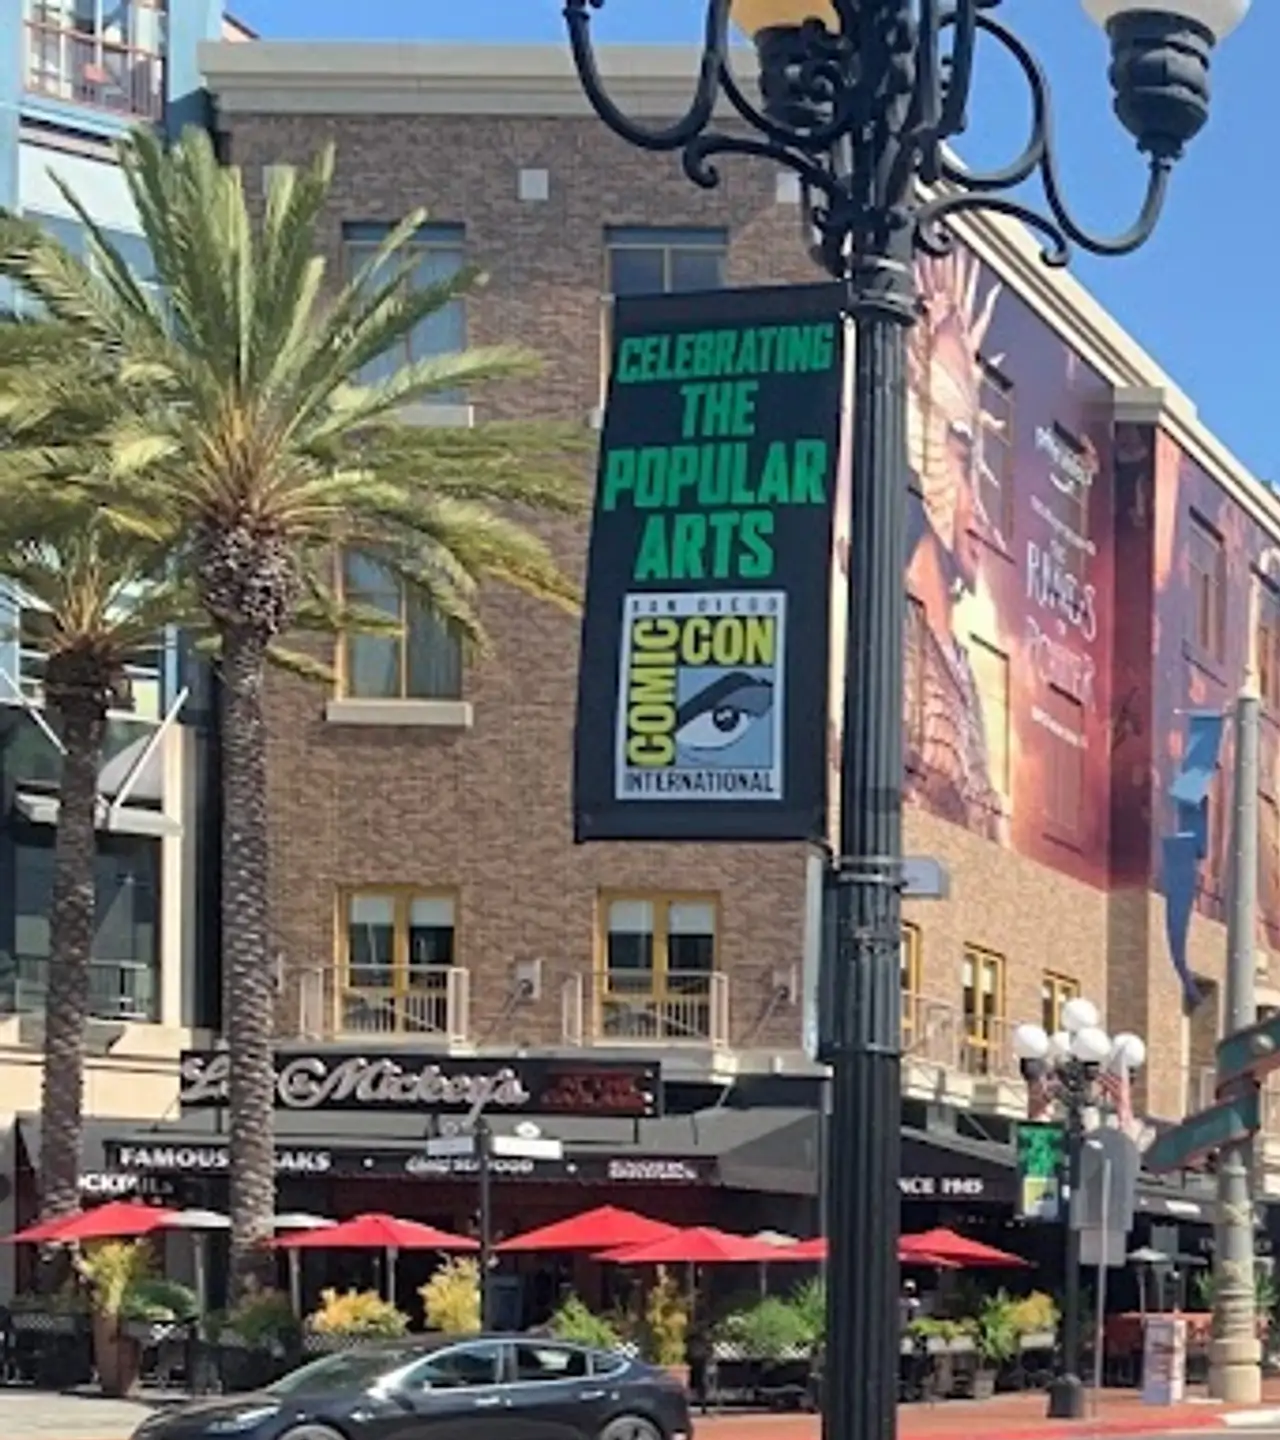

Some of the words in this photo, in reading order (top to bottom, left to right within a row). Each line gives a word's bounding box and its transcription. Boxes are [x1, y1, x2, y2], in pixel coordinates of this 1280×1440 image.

[617, 323, 835, 384] CELEBRATING
[679, 380, 759, 438] THE
[603, 438, 828, 511] POPULAR
[633, 510, 775, 581] ARTS
[631, 600, 678, 613] SAN
[697, 597, 778, 612] DIEGO
[681, 616, 775, 667] CON
[626, 618, 680, 769] COMIC
[623, 771, 774, 794] INTERNATIONAL
[119, 1146, 230, 1169] FAMOUS
